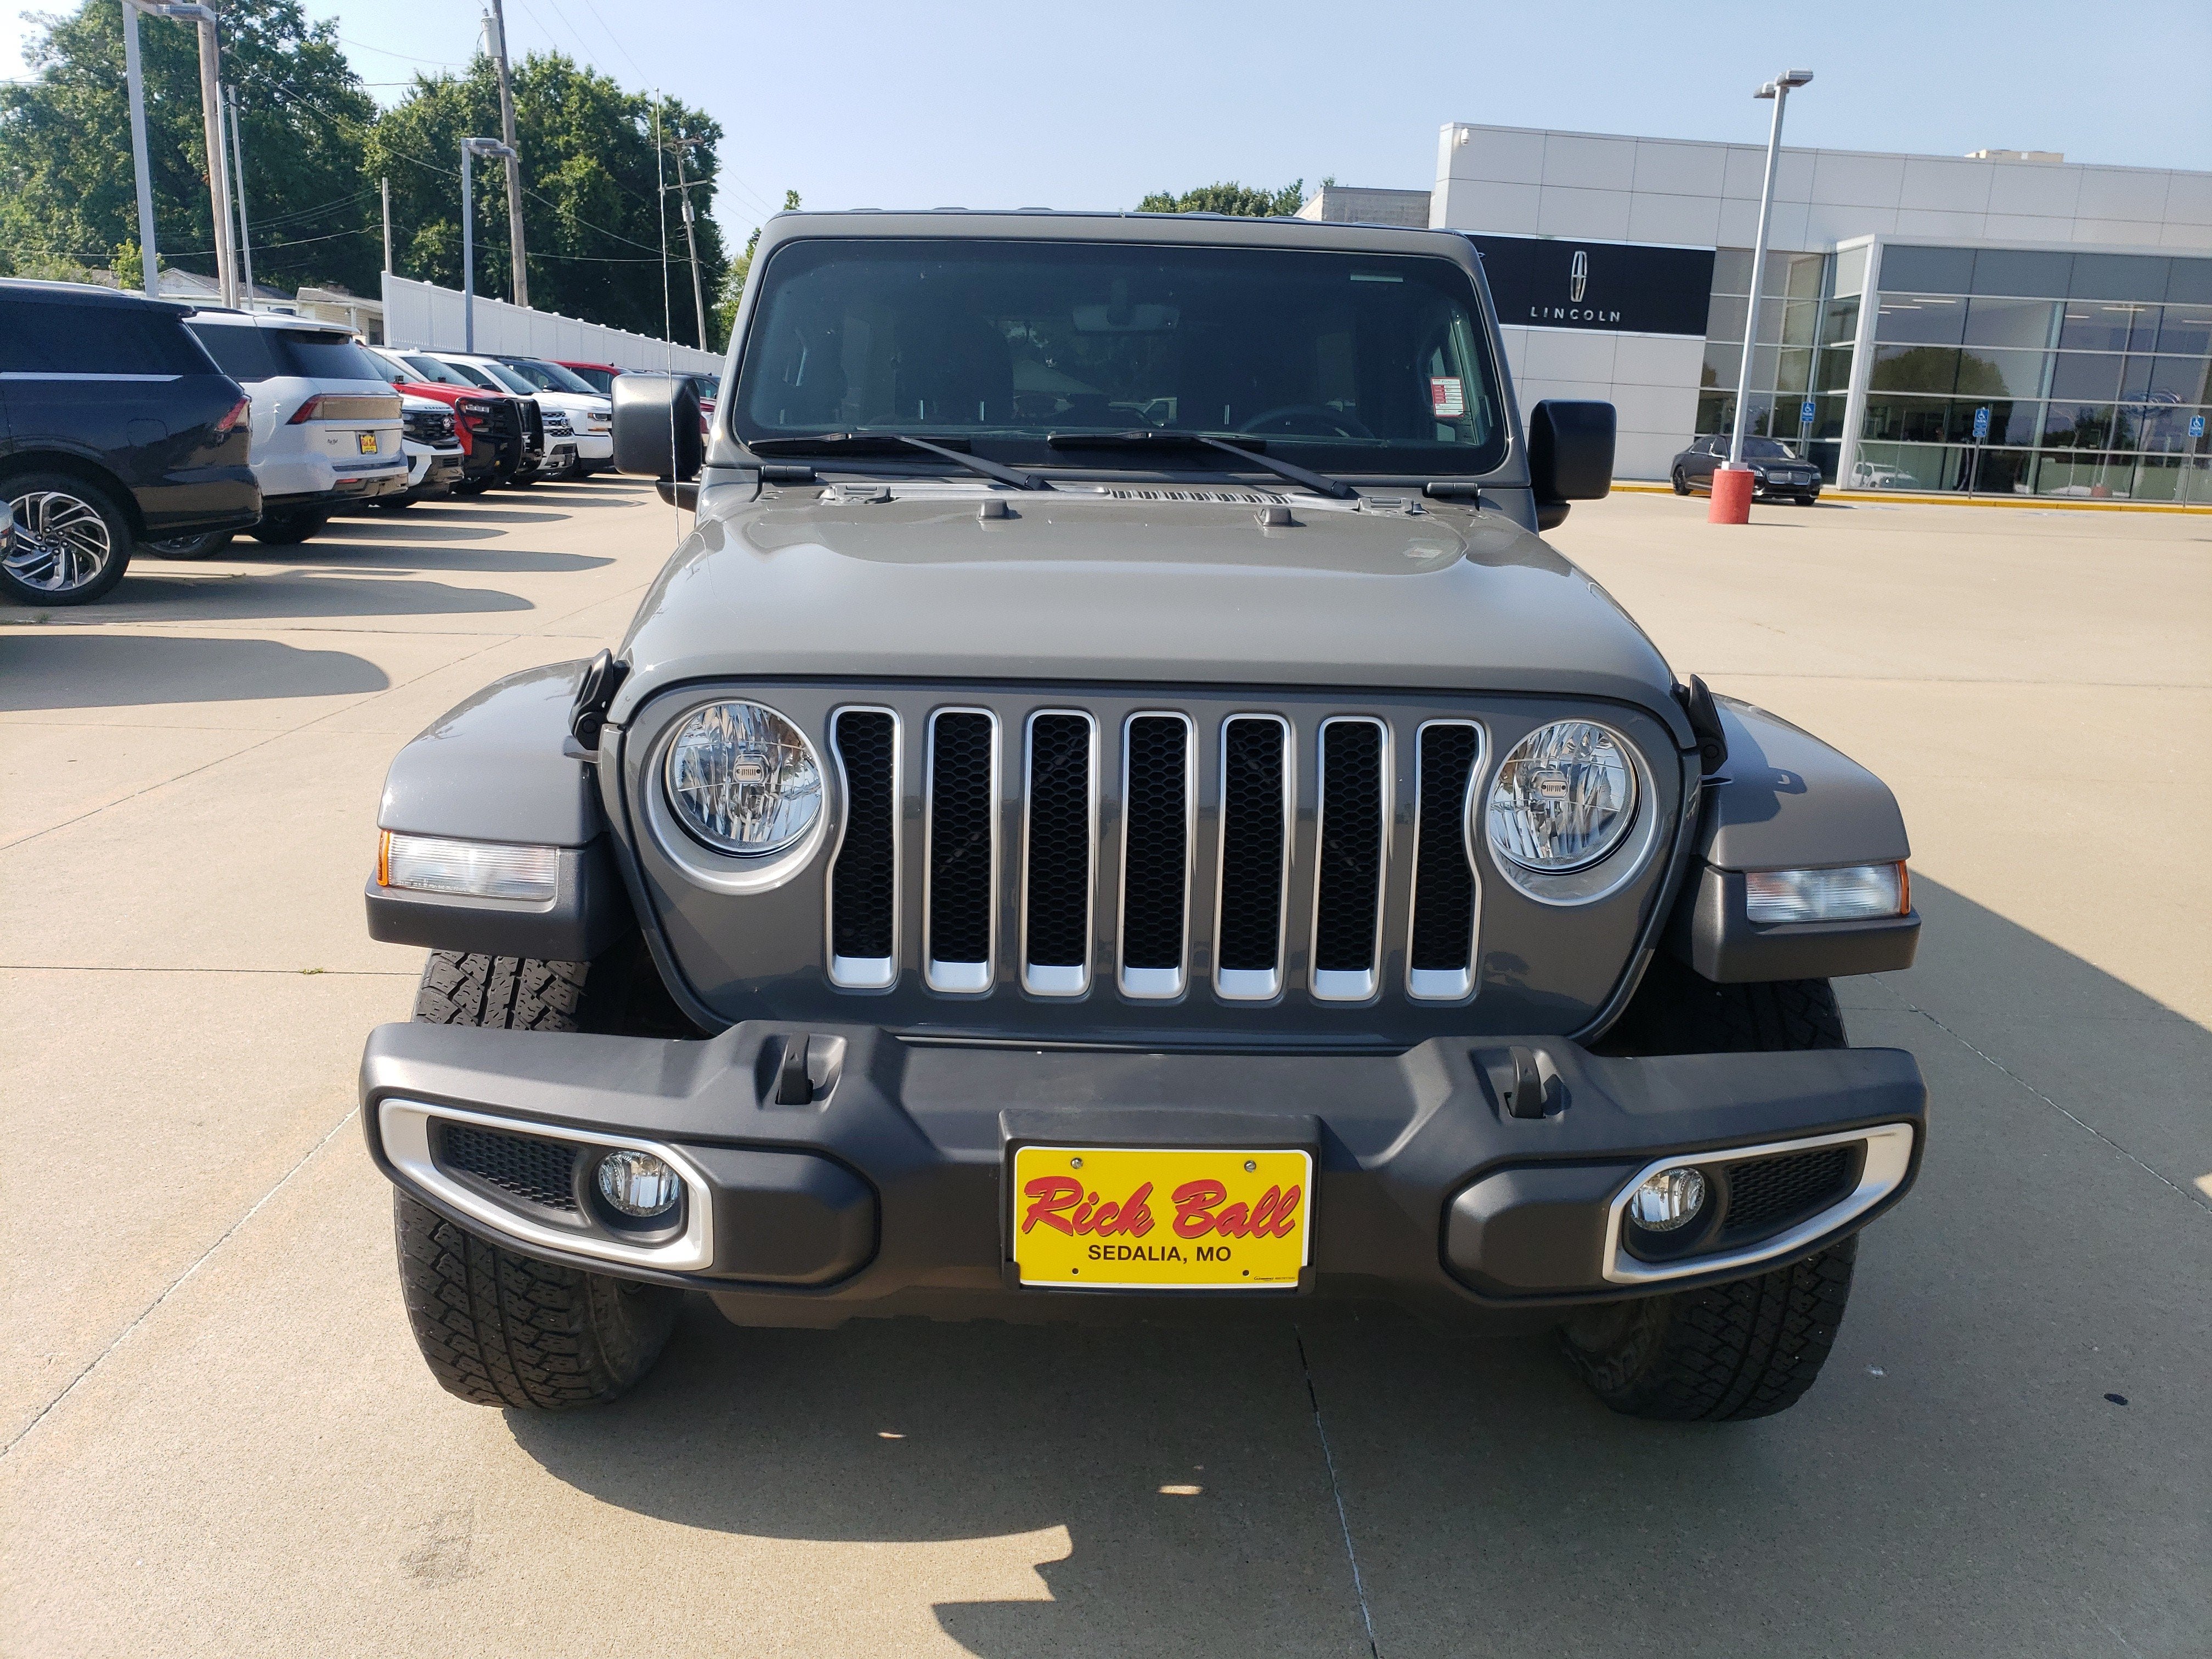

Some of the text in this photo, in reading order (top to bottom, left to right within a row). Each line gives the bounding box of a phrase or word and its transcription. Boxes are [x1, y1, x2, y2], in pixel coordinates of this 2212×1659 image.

[1530, 306, 1621, 323] LINCOLN
[1021, 1176, 1301, 1239] Rick Ball
[1088, 1244, 1232, 1264] SEDALIA, MO
